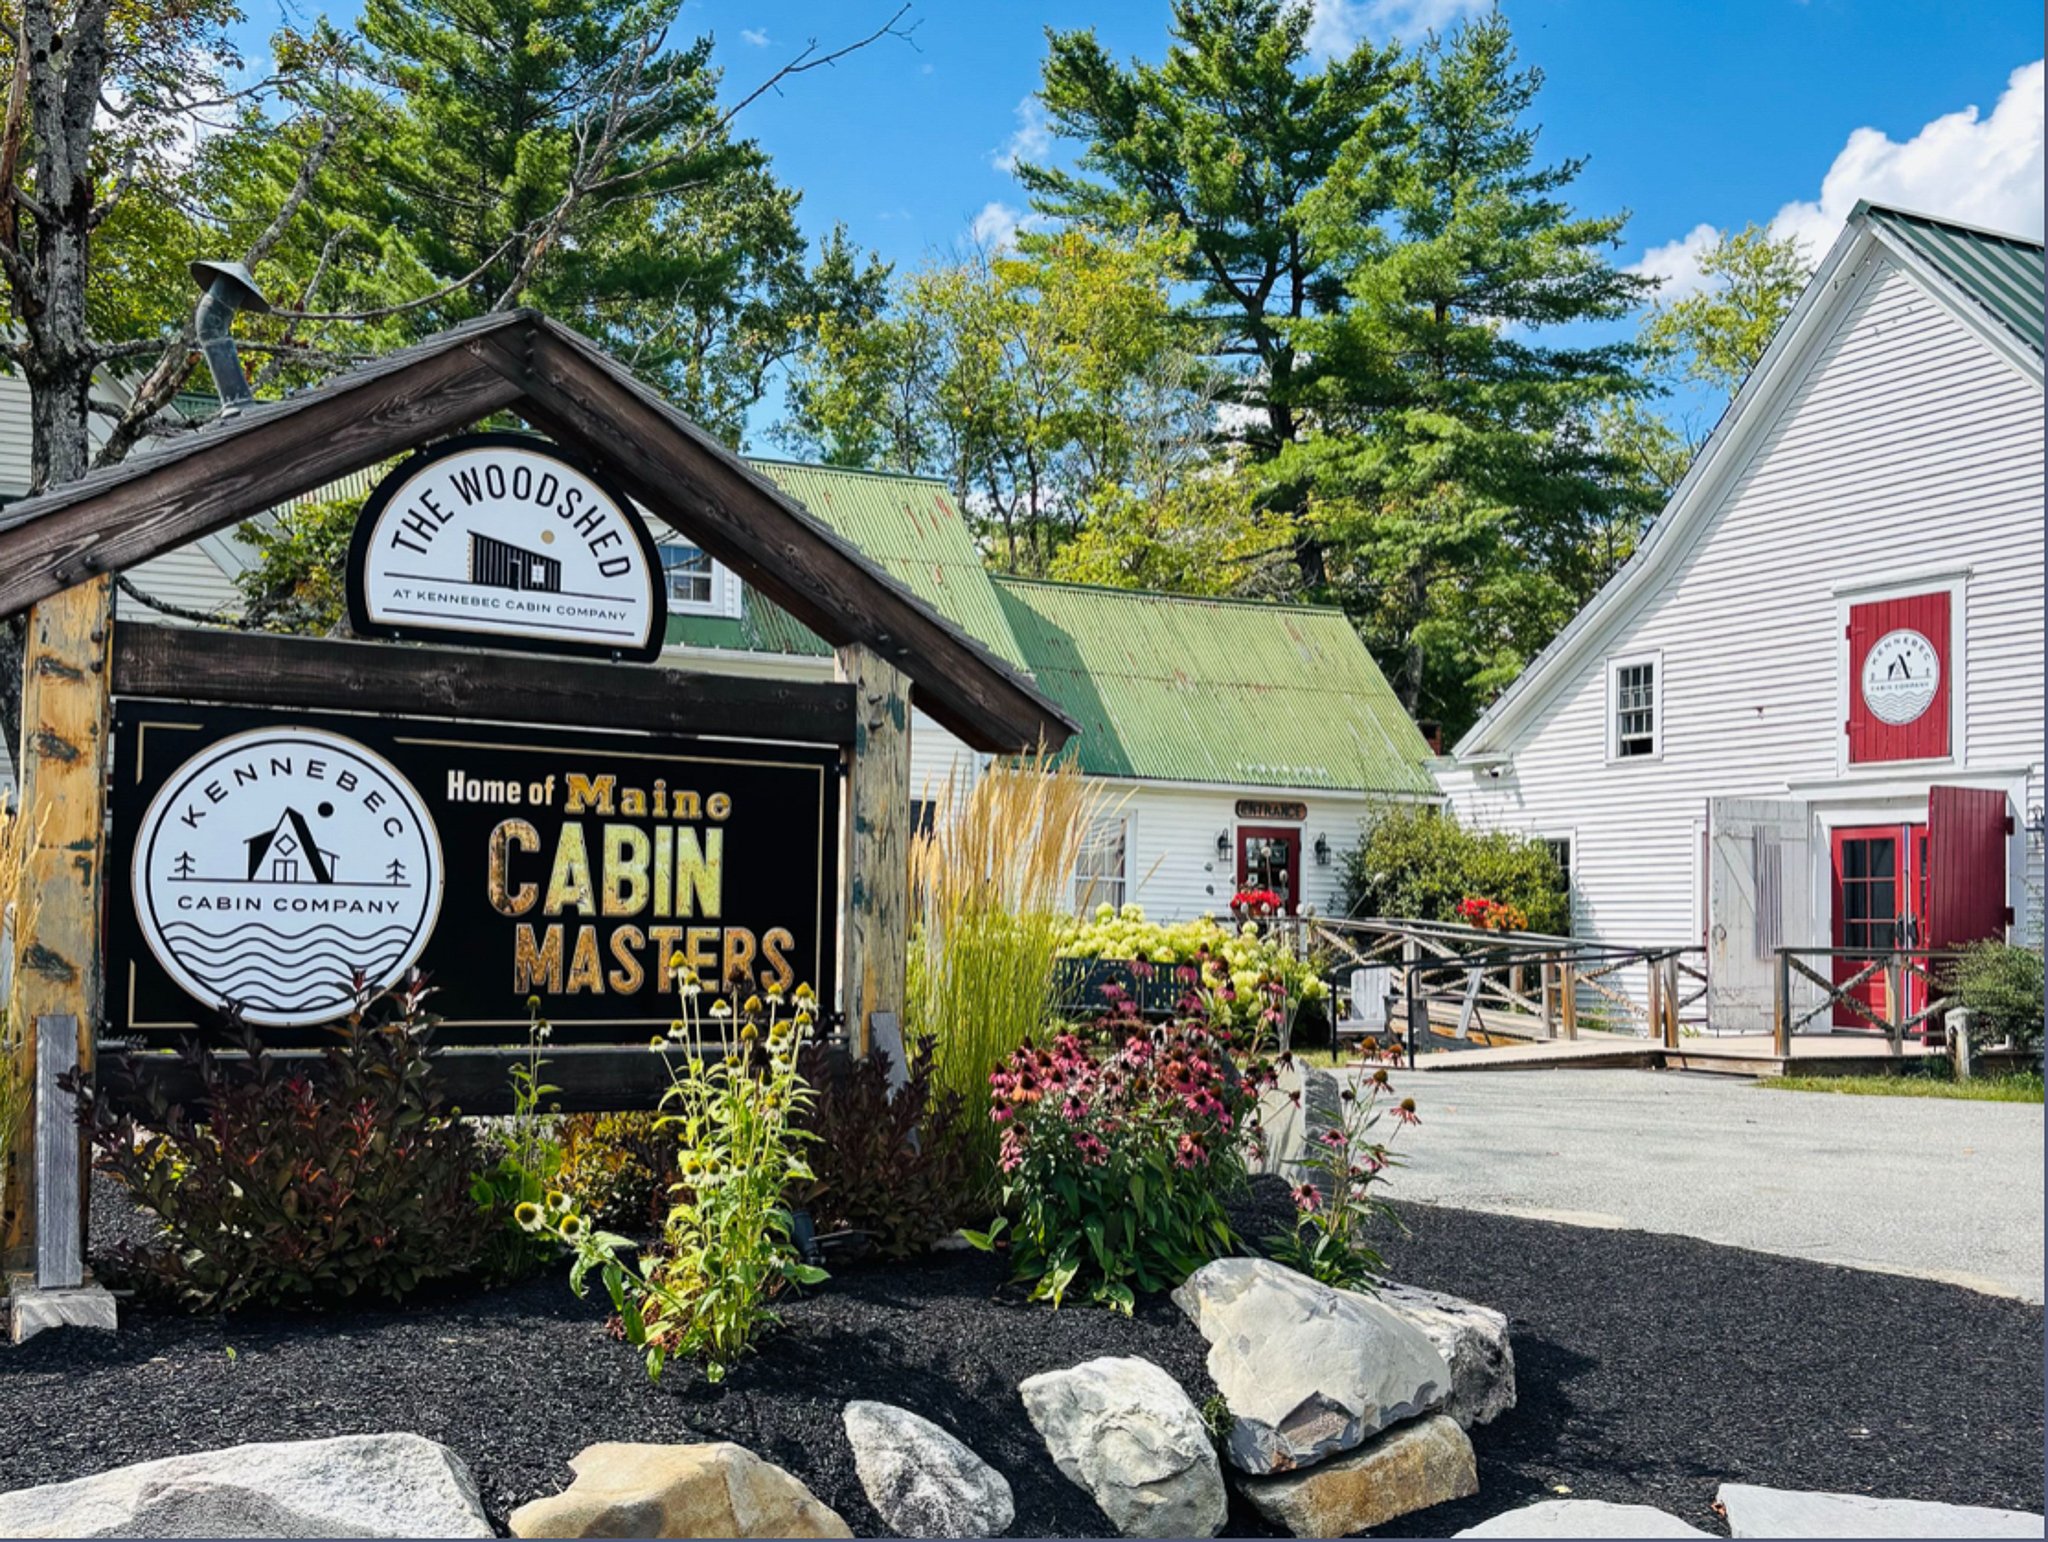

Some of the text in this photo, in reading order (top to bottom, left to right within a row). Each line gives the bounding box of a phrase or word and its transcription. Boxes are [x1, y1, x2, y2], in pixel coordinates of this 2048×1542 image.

[391, 464, 632, 579] THE WOODSHED
[393, 589, 627, 621] AT KENNEBEC CABIN COMPANY
[180, 757, 404, 838] KENNEBEC
[447, 770, 732, 821] Home of Maine
[177, 895, 400, 913] CABIN COMPANY
[488, 817, 724, 918] CABIN
[514, 922, 795, 995] MASTERS
